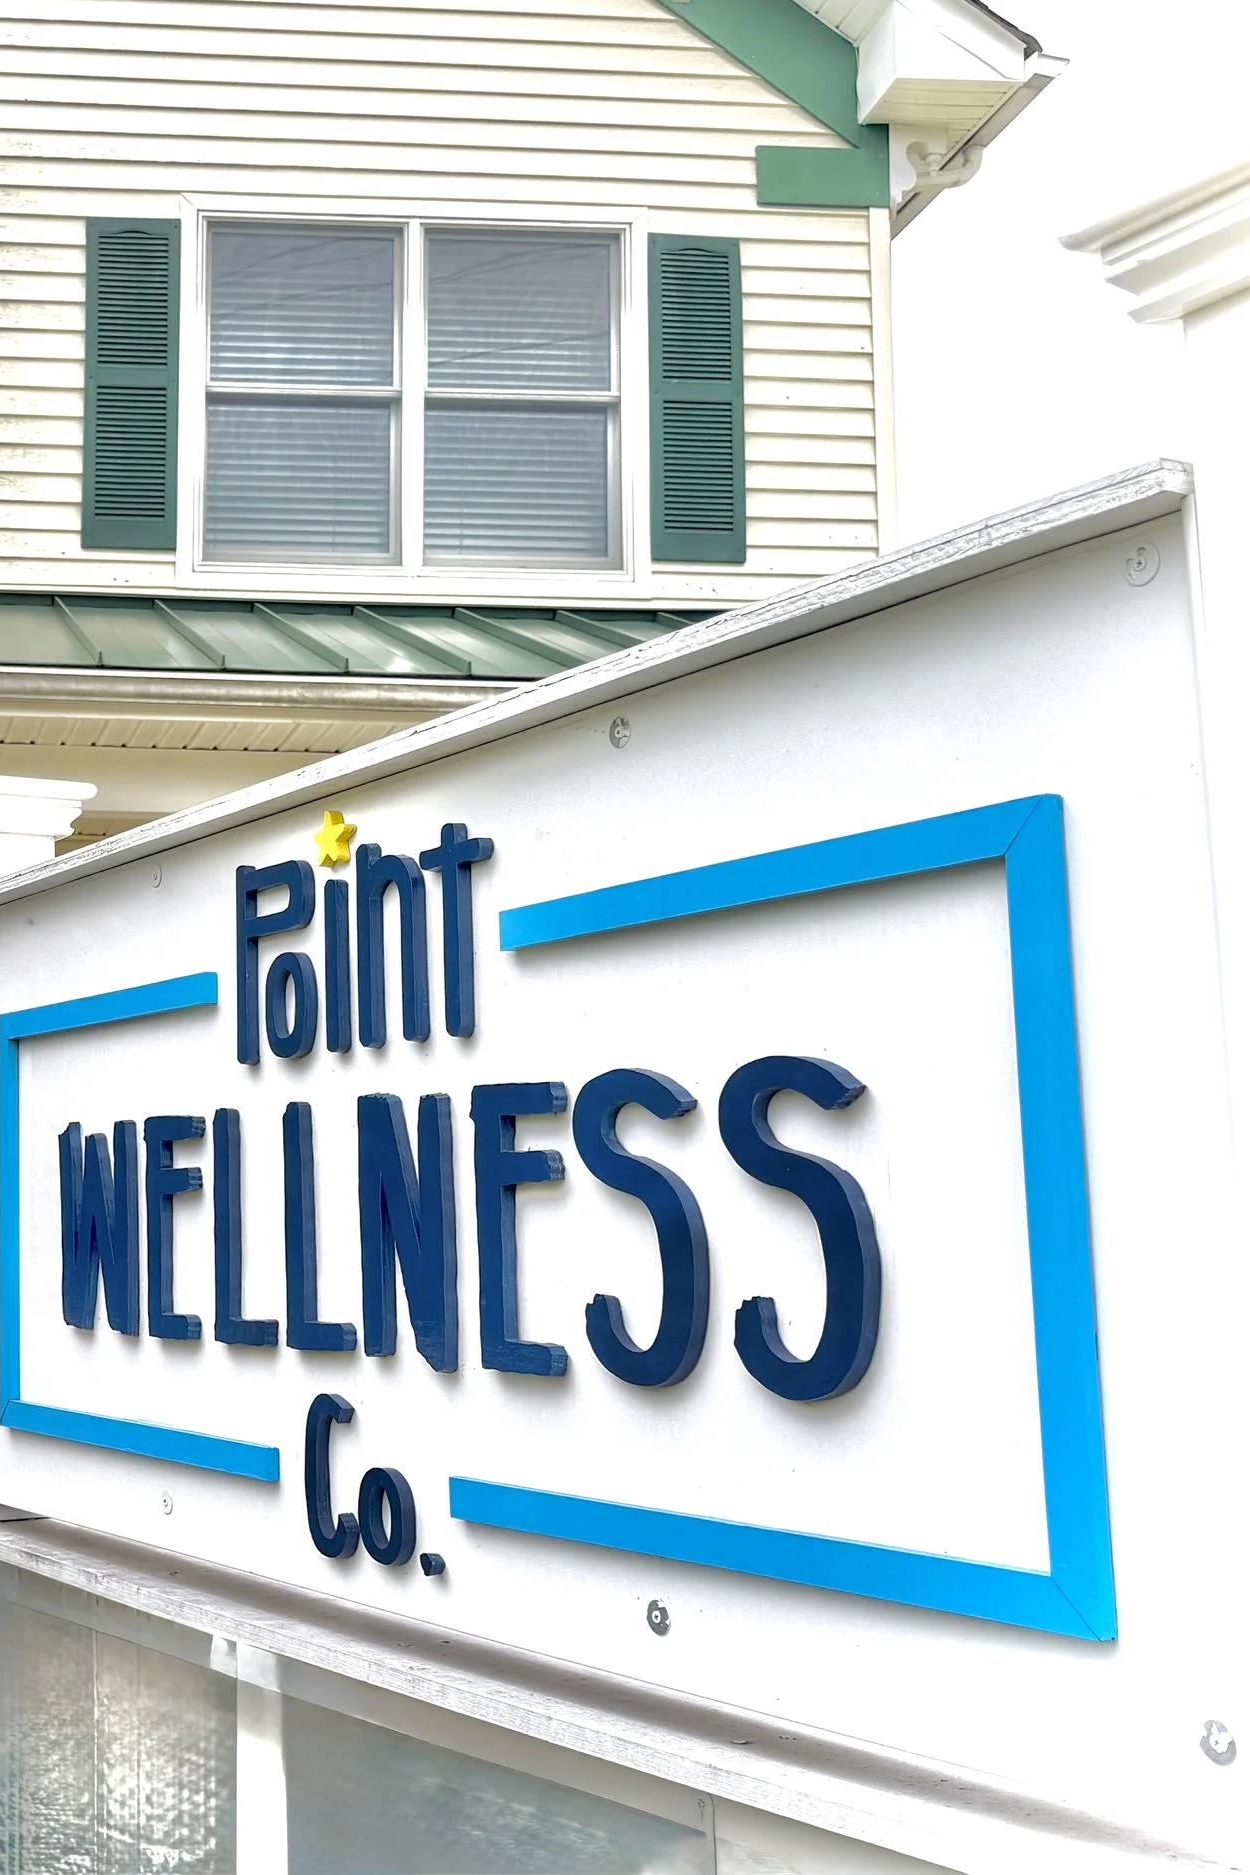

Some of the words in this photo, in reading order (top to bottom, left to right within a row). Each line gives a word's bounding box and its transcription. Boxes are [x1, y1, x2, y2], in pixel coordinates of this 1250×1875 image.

[235, 812, 494, 1066] Point
[58, 1055, 883, 1401] WELLNESS
[305, 1393, 446, 1577] Co.
